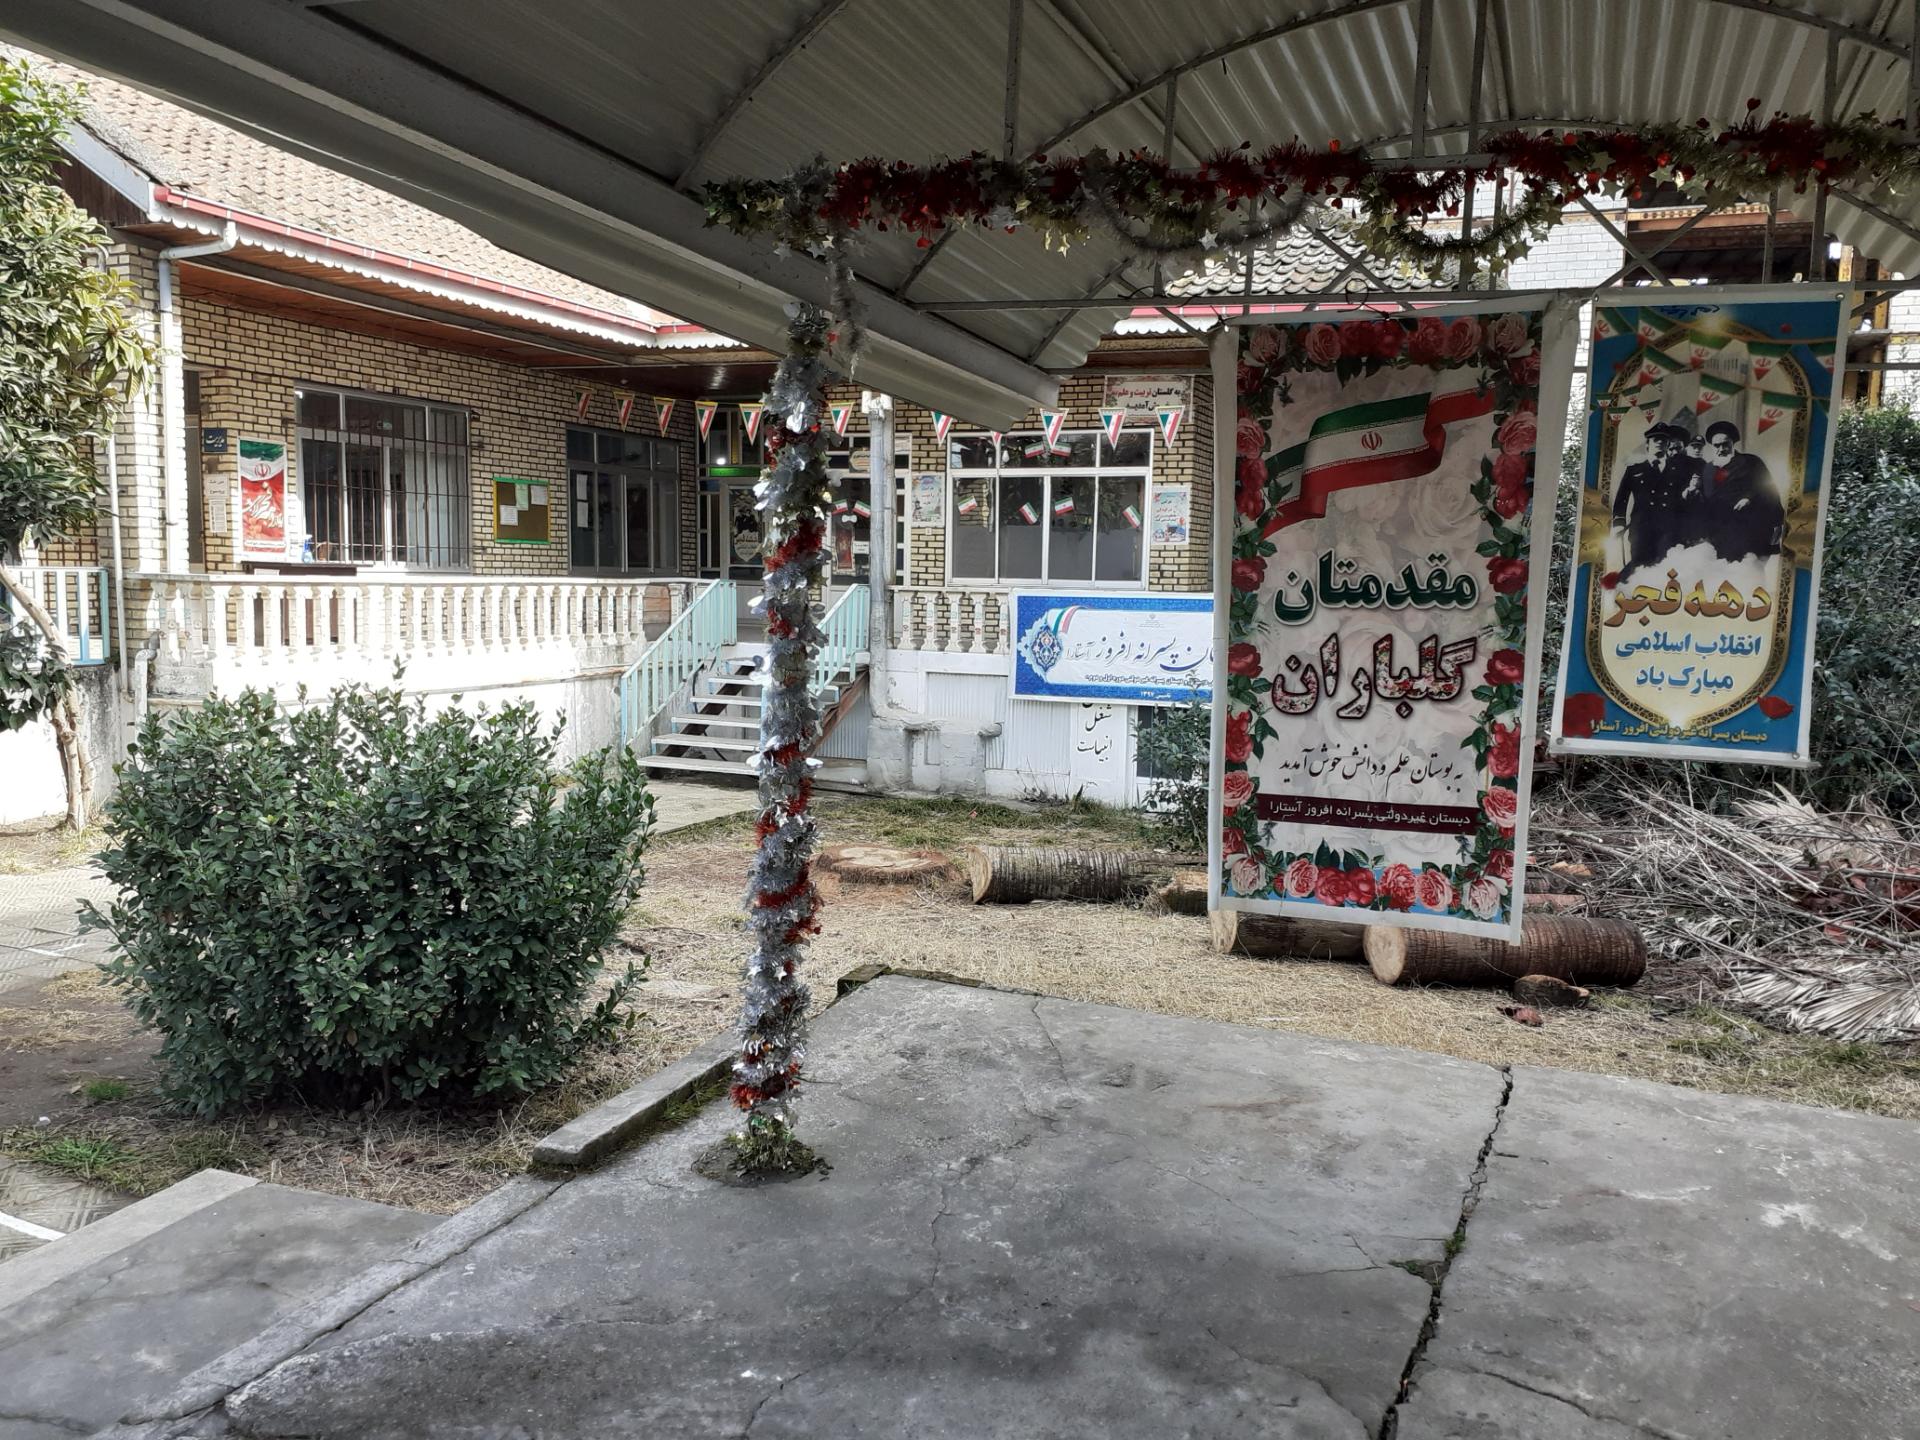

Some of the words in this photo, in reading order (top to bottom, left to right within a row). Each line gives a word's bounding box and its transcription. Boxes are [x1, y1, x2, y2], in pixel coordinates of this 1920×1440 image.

[1273, 548, 1479, 625] مقدمتان
[1604, 568, 1682, 627] فجر
[1684, 579, 1772, 621] دهه
[1066, 641, 1096, 661] آستارا
[1096, 631, 1132, 668] افروز
[1133, 637, 1179, 665] پسرانه
[1615, 630, 1691, 657] اسلامی
[1695, 633, 1762, 659] انقلاب
[1272, 633, 1477, 720] گلباران
[1636, 666, 1665, 691] باد
[1667, 666, 1734, 694] مبارک
[1085, 704, 1112, 732] شغل
[1590, 719, 1620, 734] آستارا
[1077, 735, 1112, 762] انبیاست
[1309, 743, 1342, 778] خوش
[1342, 744, 1378, 780] دانش
[1280, 748, 1314, 783] آمدید
[1385, 752, 1410, 797] علم
[1411, 753, 1454, 792] بوستان
[1454, 772, 1464, 793] به
[1269, 800, 1303, 814] آستارا
[1305, 804, 1333, 817] افروز
[1336, 806, 1375, 822] پسرانه
[1429, 812, 1471, 826] دبستان
